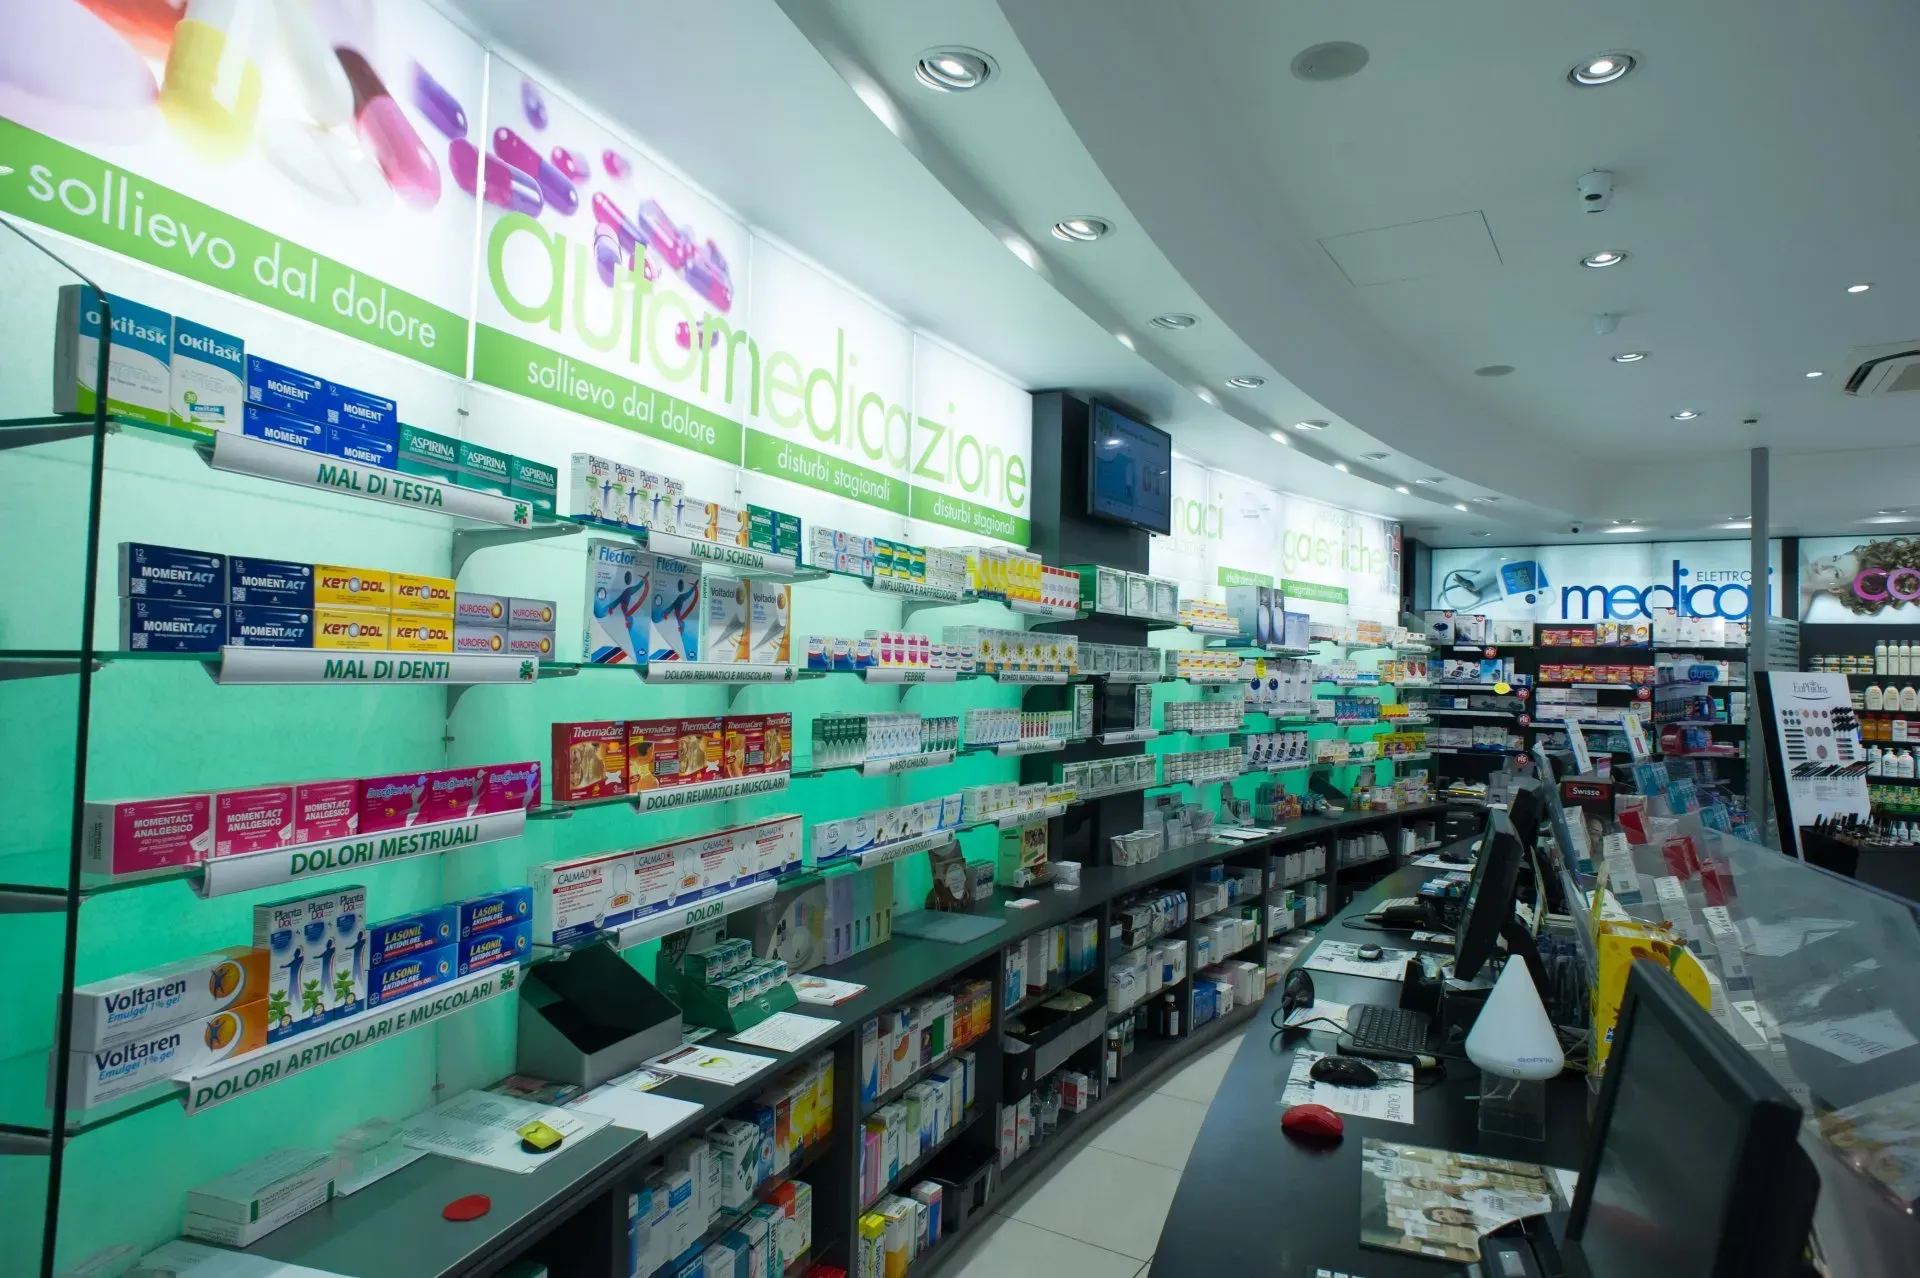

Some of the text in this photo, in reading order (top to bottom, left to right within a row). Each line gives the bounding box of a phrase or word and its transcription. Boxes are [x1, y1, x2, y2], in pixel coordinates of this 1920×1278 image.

[27, 164, 436, 349] sollievo dal dolore
[487, 212, 1026, 509] automedicazione
[267, 379, 310, 400] MOMENT
[528, 358, 715, 445] sollievo dal dolore
[344, 403, 383, 422] MOMENT
[264, 426, 310, 446] MOMENT
[411, 436, 454, 457] ASPIRINA
[344, 446, 382, 464] MOMENT
[467, 452, 506, 470] ASPIRINA
[520, 466, 554, 483] ASPIRINA
[778, 444, 890, 502] disturbi stagionali
[317, 464, 442, 507] MAL DI TESTA
[933, 501, 1015, 536] disturbi stagionali
[135, 549, 144, 557] 12
[599, 546, 635, 565] Flector
[690, 541, 764, 569] MAL DI SCHIENA
[656, 557, 688, 573] Flector
[142, 566, 215, 584] MOMENTACT
[241, 576, 306, 591] MOMENTACT
[880, 578, 914, 594] INFLUENZA
[914, 584, 919, 593] E
[1562, 560, 1772, 620] medicai
[711, 587, 735, 598] Voltadol
[753, 593, 776, 603] Voltadol
[137, 603, 145, 611] 12
[234, 609, 243, 617] 12
[459, 603, 491, 616] NUROFEN
[512, 608, 541, 619] NUROFEN
[143, 620, 217, 634] MOMENTACT
[241, 625, 304, 637] MOMENTACT
[457, 638, 490, 648] NUROFEN
[510, 639, 540, 650] NUROFEN
[324, 660, 449, 679] MAL DI DENTI
[665, 670, 772, 681] DOLORI REUMATICI E MUSCOLARI
[1690, 667, 1717, 680] durex
[680, 720, 721, 732] ThermaCare
[727, 720, 763, 730] ThermaCare
[766, 716, 791, 726] ThermaCare
[573, 725, 624, 738] ThermaCare
[631, 724, 677, 736] ThermaCare
[647, 777, 785, 810] DOLORI REUMATICI E MUSCOLARI
[1572, 787, 1601, 797] Swisse
[304, 800, 351, 813] MOMENTACT
[134, 814, 194, 828] MOMENTACT
[227, 808, 283, 823] MOMENTACT
[305, 808, 350, 821] ANALGESICO
[134, 824, 193, 838] ANALGESICO
[228, 818, 282, 832] ANALGESICO
[291, 824, 479, 876] DOLORI MESTRUALI
[308, 900, 334, 914] Planta
[340, 893, 364, 906] Planta
[343, 902, 355, 912] Dol
[275, 907, 302, 922] Planta
[311, 910, 324, 921] Dol
[472, 903, 504, 919] LASONIL
[686, 901, 724, 925] DOLORI
[278, 917, 292, 928] Dol
[384, 925, 422, 944] LASONIL
[470, 938, 502, 956] LASONIL
[382, 963, 420, 984] LASONIL
[104, 979, 186, 1013] Voltaren
[107, 996, 181, 1024] Emulgel 1% gel
[95, 1032, 180, 1071] Voltaren
[195, 981, 491, 1108] DOLORI ARTICOLARI E MUSCOLARI
[98, 1050, 174, 1081] Emulgel 1% gel
